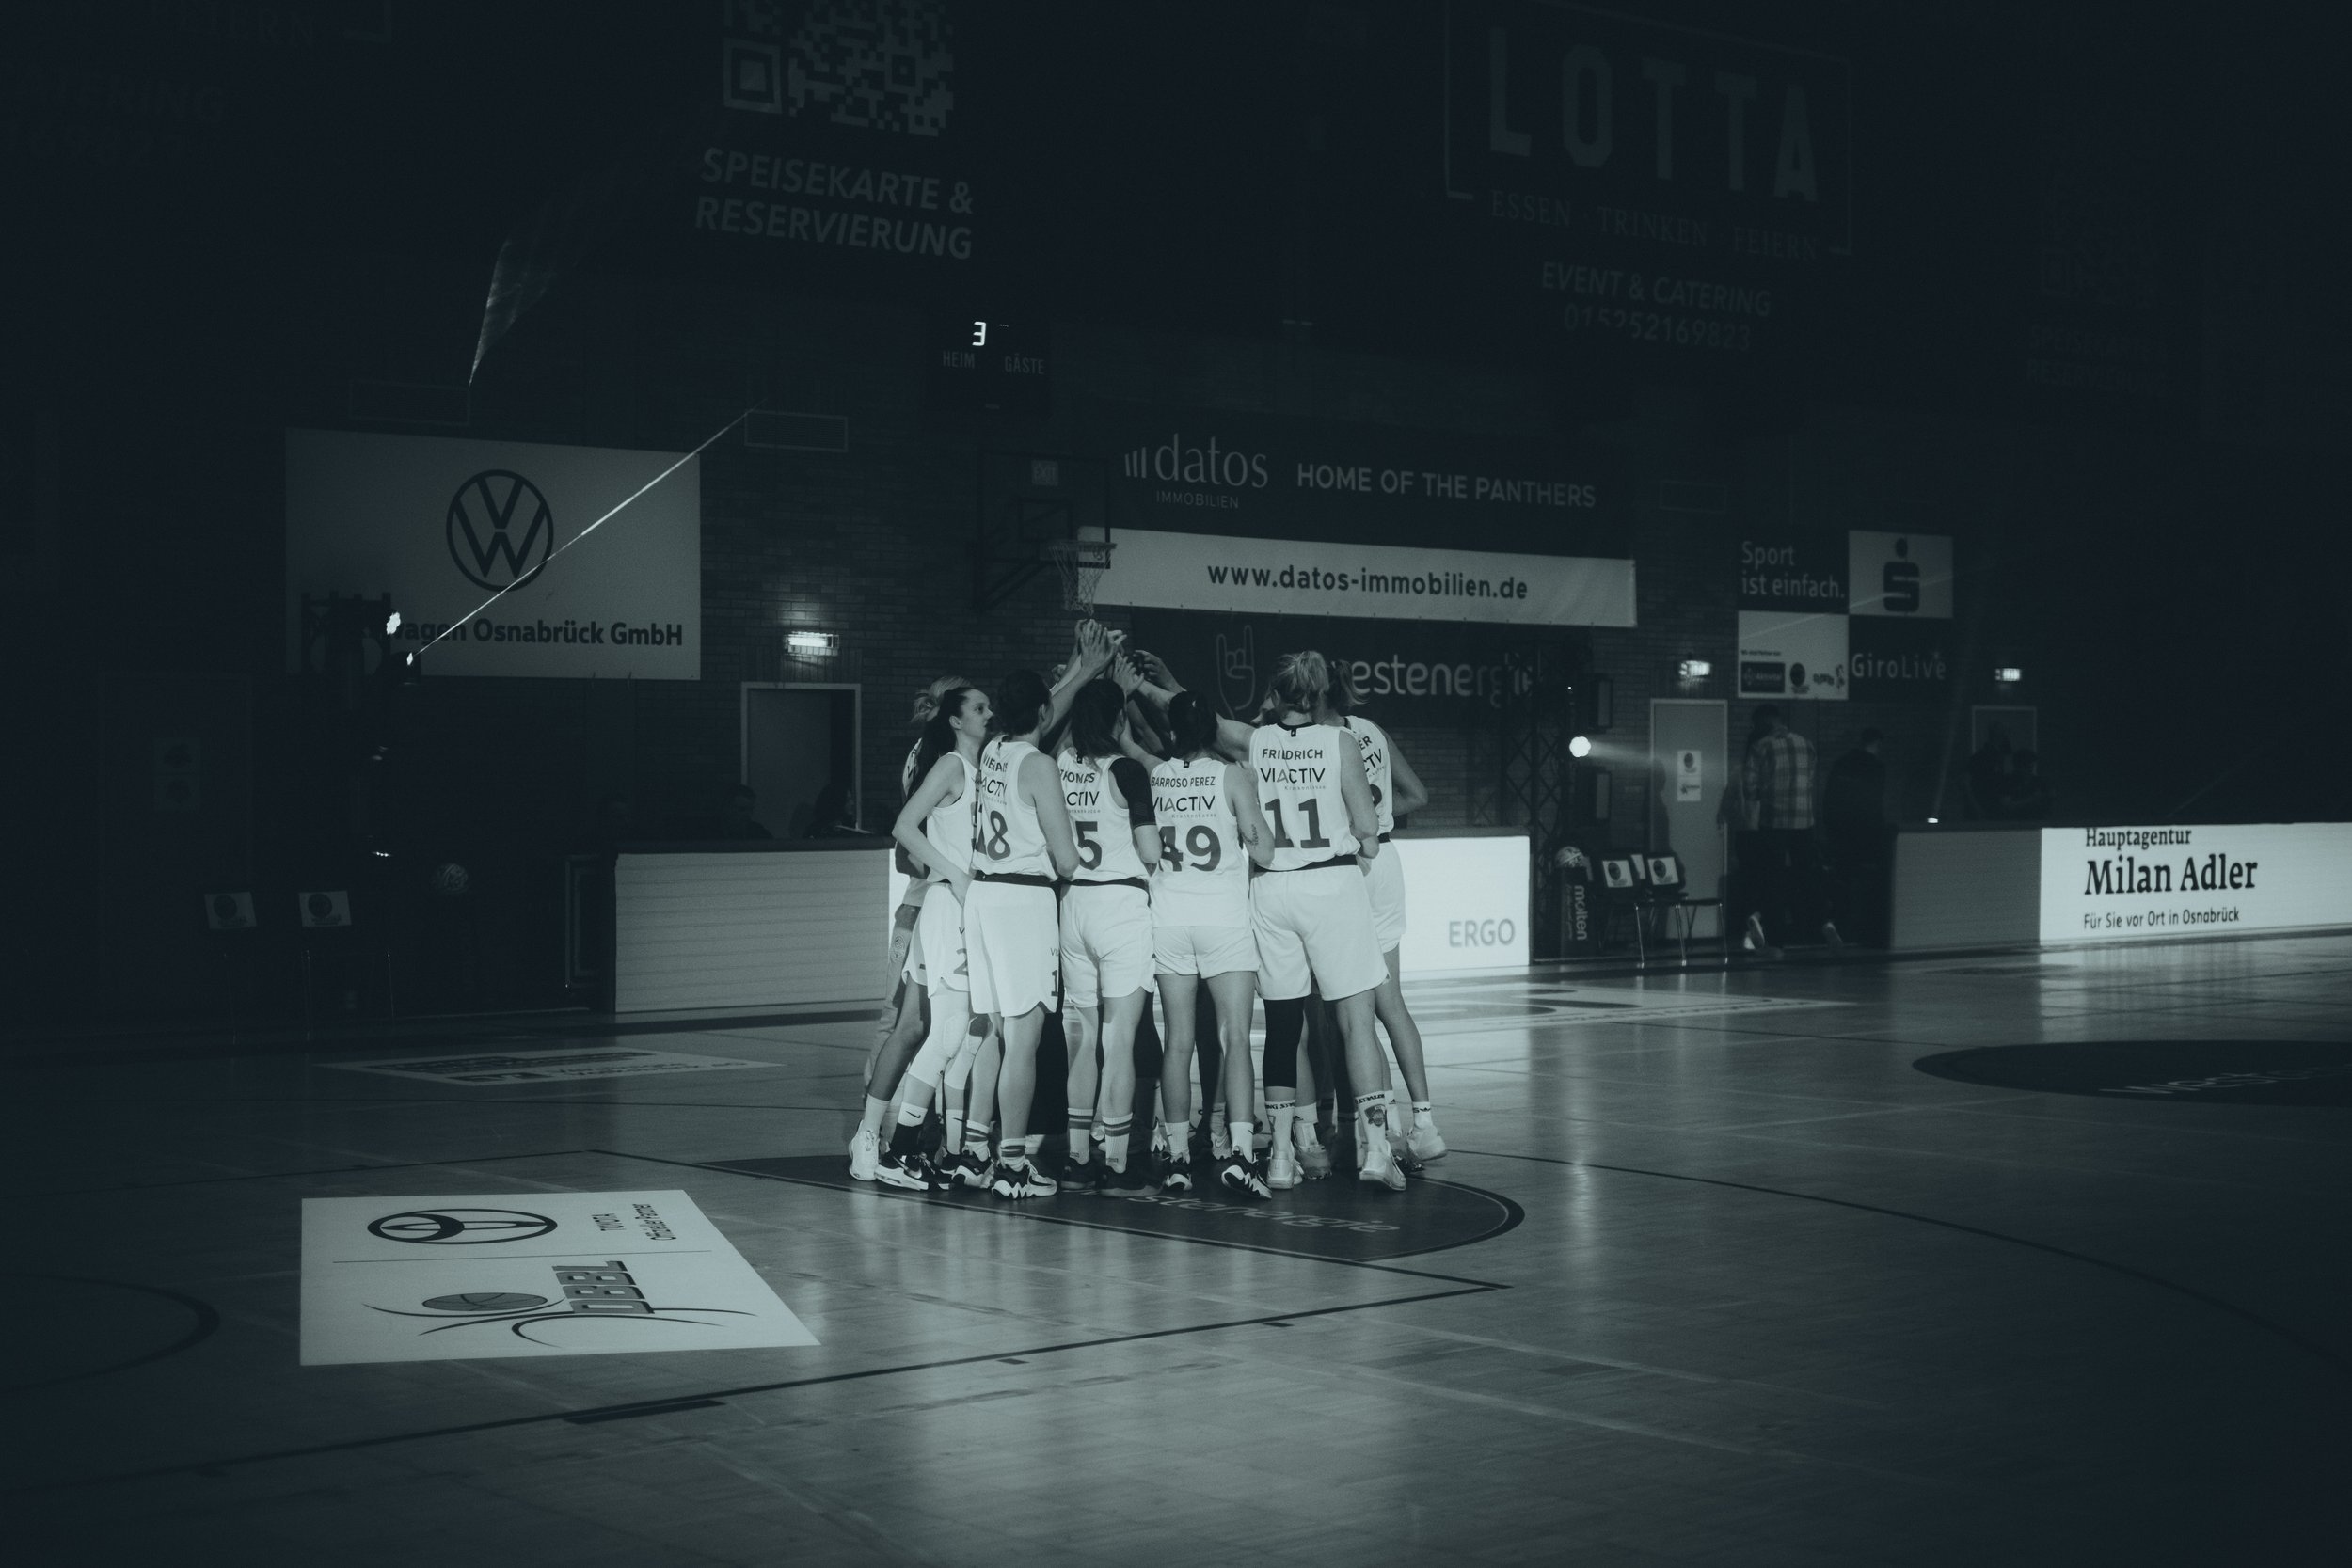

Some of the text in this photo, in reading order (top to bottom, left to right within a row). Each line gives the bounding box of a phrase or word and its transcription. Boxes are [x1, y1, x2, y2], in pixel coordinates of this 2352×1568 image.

[2, 61, 227, 123] ATERING
[1489, 26, 1819, 202] LOTTA
[700, 147, 973, 214] SPEISEKARTE &
[694, 196, 972, 260] RESERVIERUNG
[1490, 189, 1818, 262] ESSEN TRINKEN FEIERN
[1541, 261, 1772, 318] EVENT & CATERING
[972, 321, 987, 346] 3
[943, 349, 1046, 375] HEIM GÄSTE
[1154, 431, 1269, 489] datos
[1155, 489, 1239, 510] IMMOBILIEN
[1297, 462, 1597, 509] HOME OF THE PANTHERS
[1740, 540, 1797, 571] Sport
[1207, 564, 1529, 600] www.datos-immobilien.de
[1740, 570, 1846, 599] ist einfach.
[474, 618, 604, 645] Osnabrück
[610, 622, 684, 646] GmbH
[1851, 651, 1947, 681] GiroLive
[1151, 776, 1216, 788] BARROSO PEREZ
[1260, 768, 1326, 784] VIACTIV
[1066, 791, 1100, 807] CTIV
[1264, 799, 1331, 849] 11
[2086, 828, 2192, 850] Hauptagentur
[1074, 821, 1103, 871] 5
[1158, 825, 1221, 873] 49
[2084, 853, 2259, 895] Milan Adler
[1573, 884, 1589, 941] molten
[2083, 906, 2240, 930] Für Sie vor Ort in Osnabrück
[1449, 918, 1515, 947] ERGO
